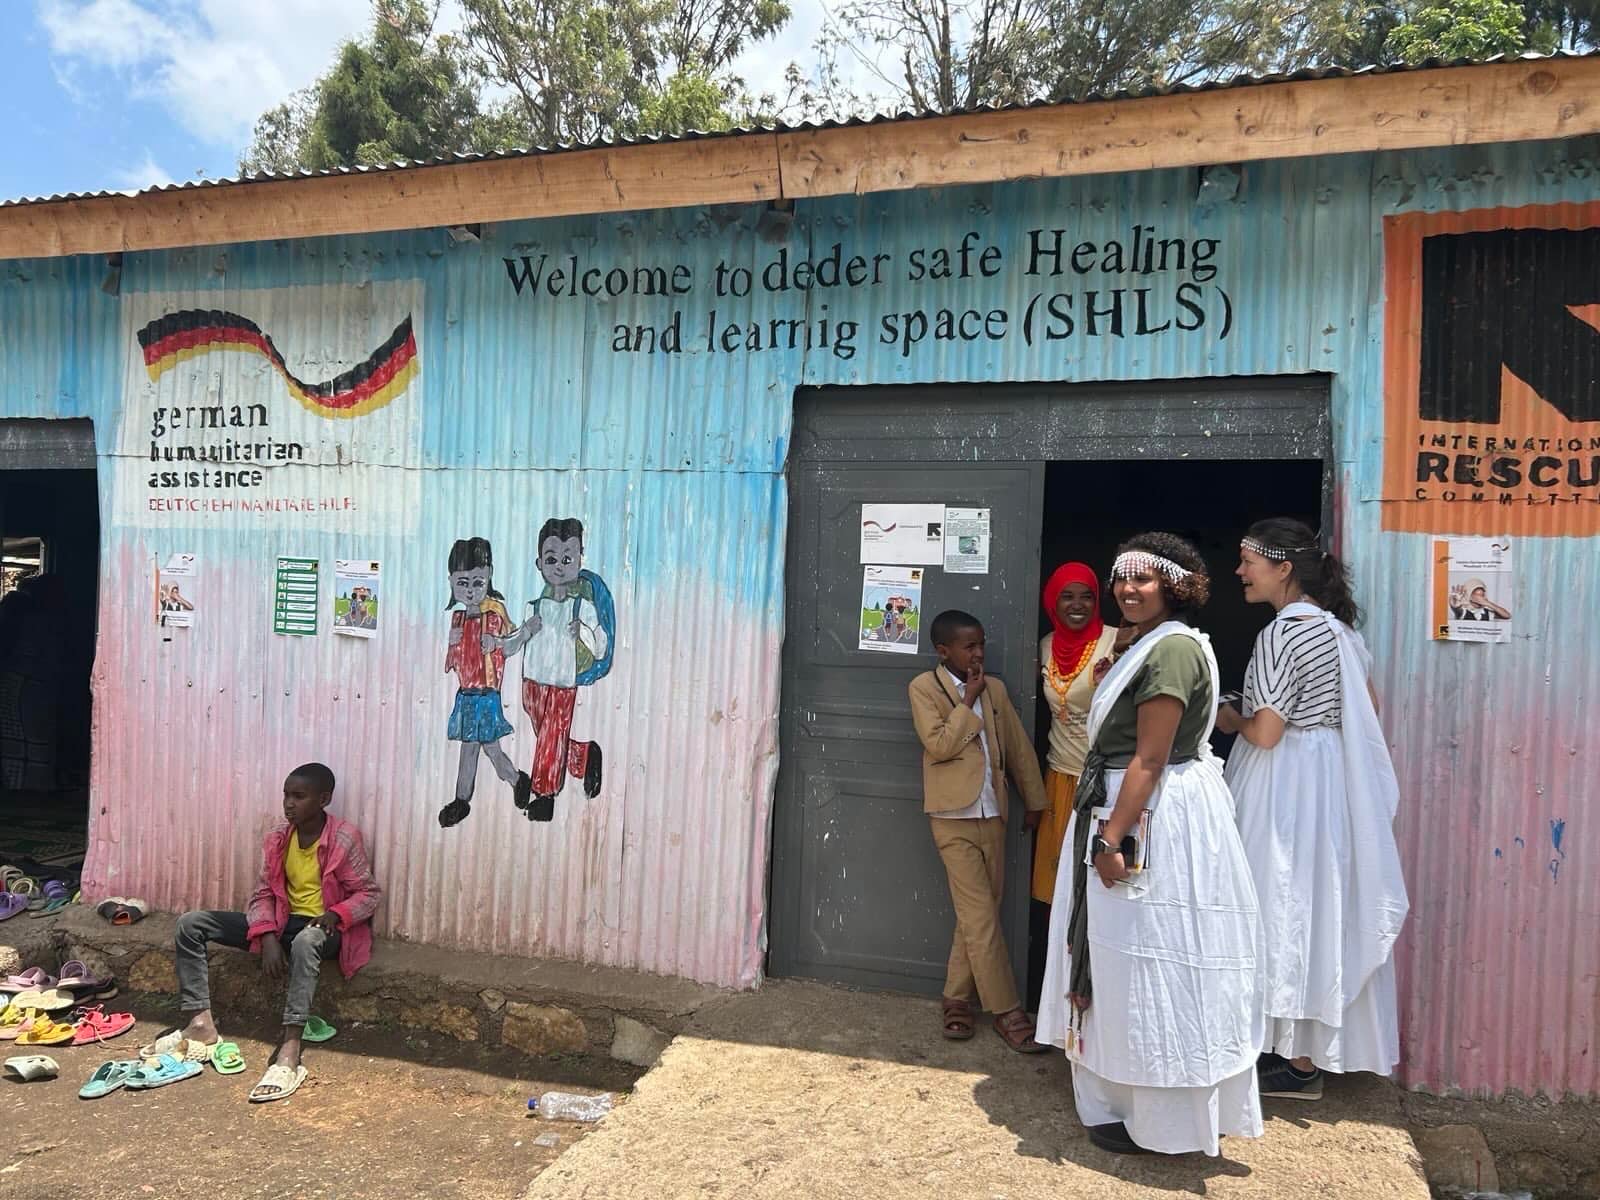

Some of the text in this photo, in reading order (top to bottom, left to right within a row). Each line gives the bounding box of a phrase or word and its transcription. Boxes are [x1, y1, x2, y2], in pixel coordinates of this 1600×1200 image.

[502, 225, 1221, 297] Welcome to deder safe Healing
[612, 310, 682, 354] and
[879, 308, 1009, 357] space
[1023, 282, 1232, 347] (SHLS)
[150, 402, 269, 437] german
[150, 436, 303, 462] humanitarian
[148, 468, 263, 488] assistance
[1416, 488, 1600, 506] COMMITT
